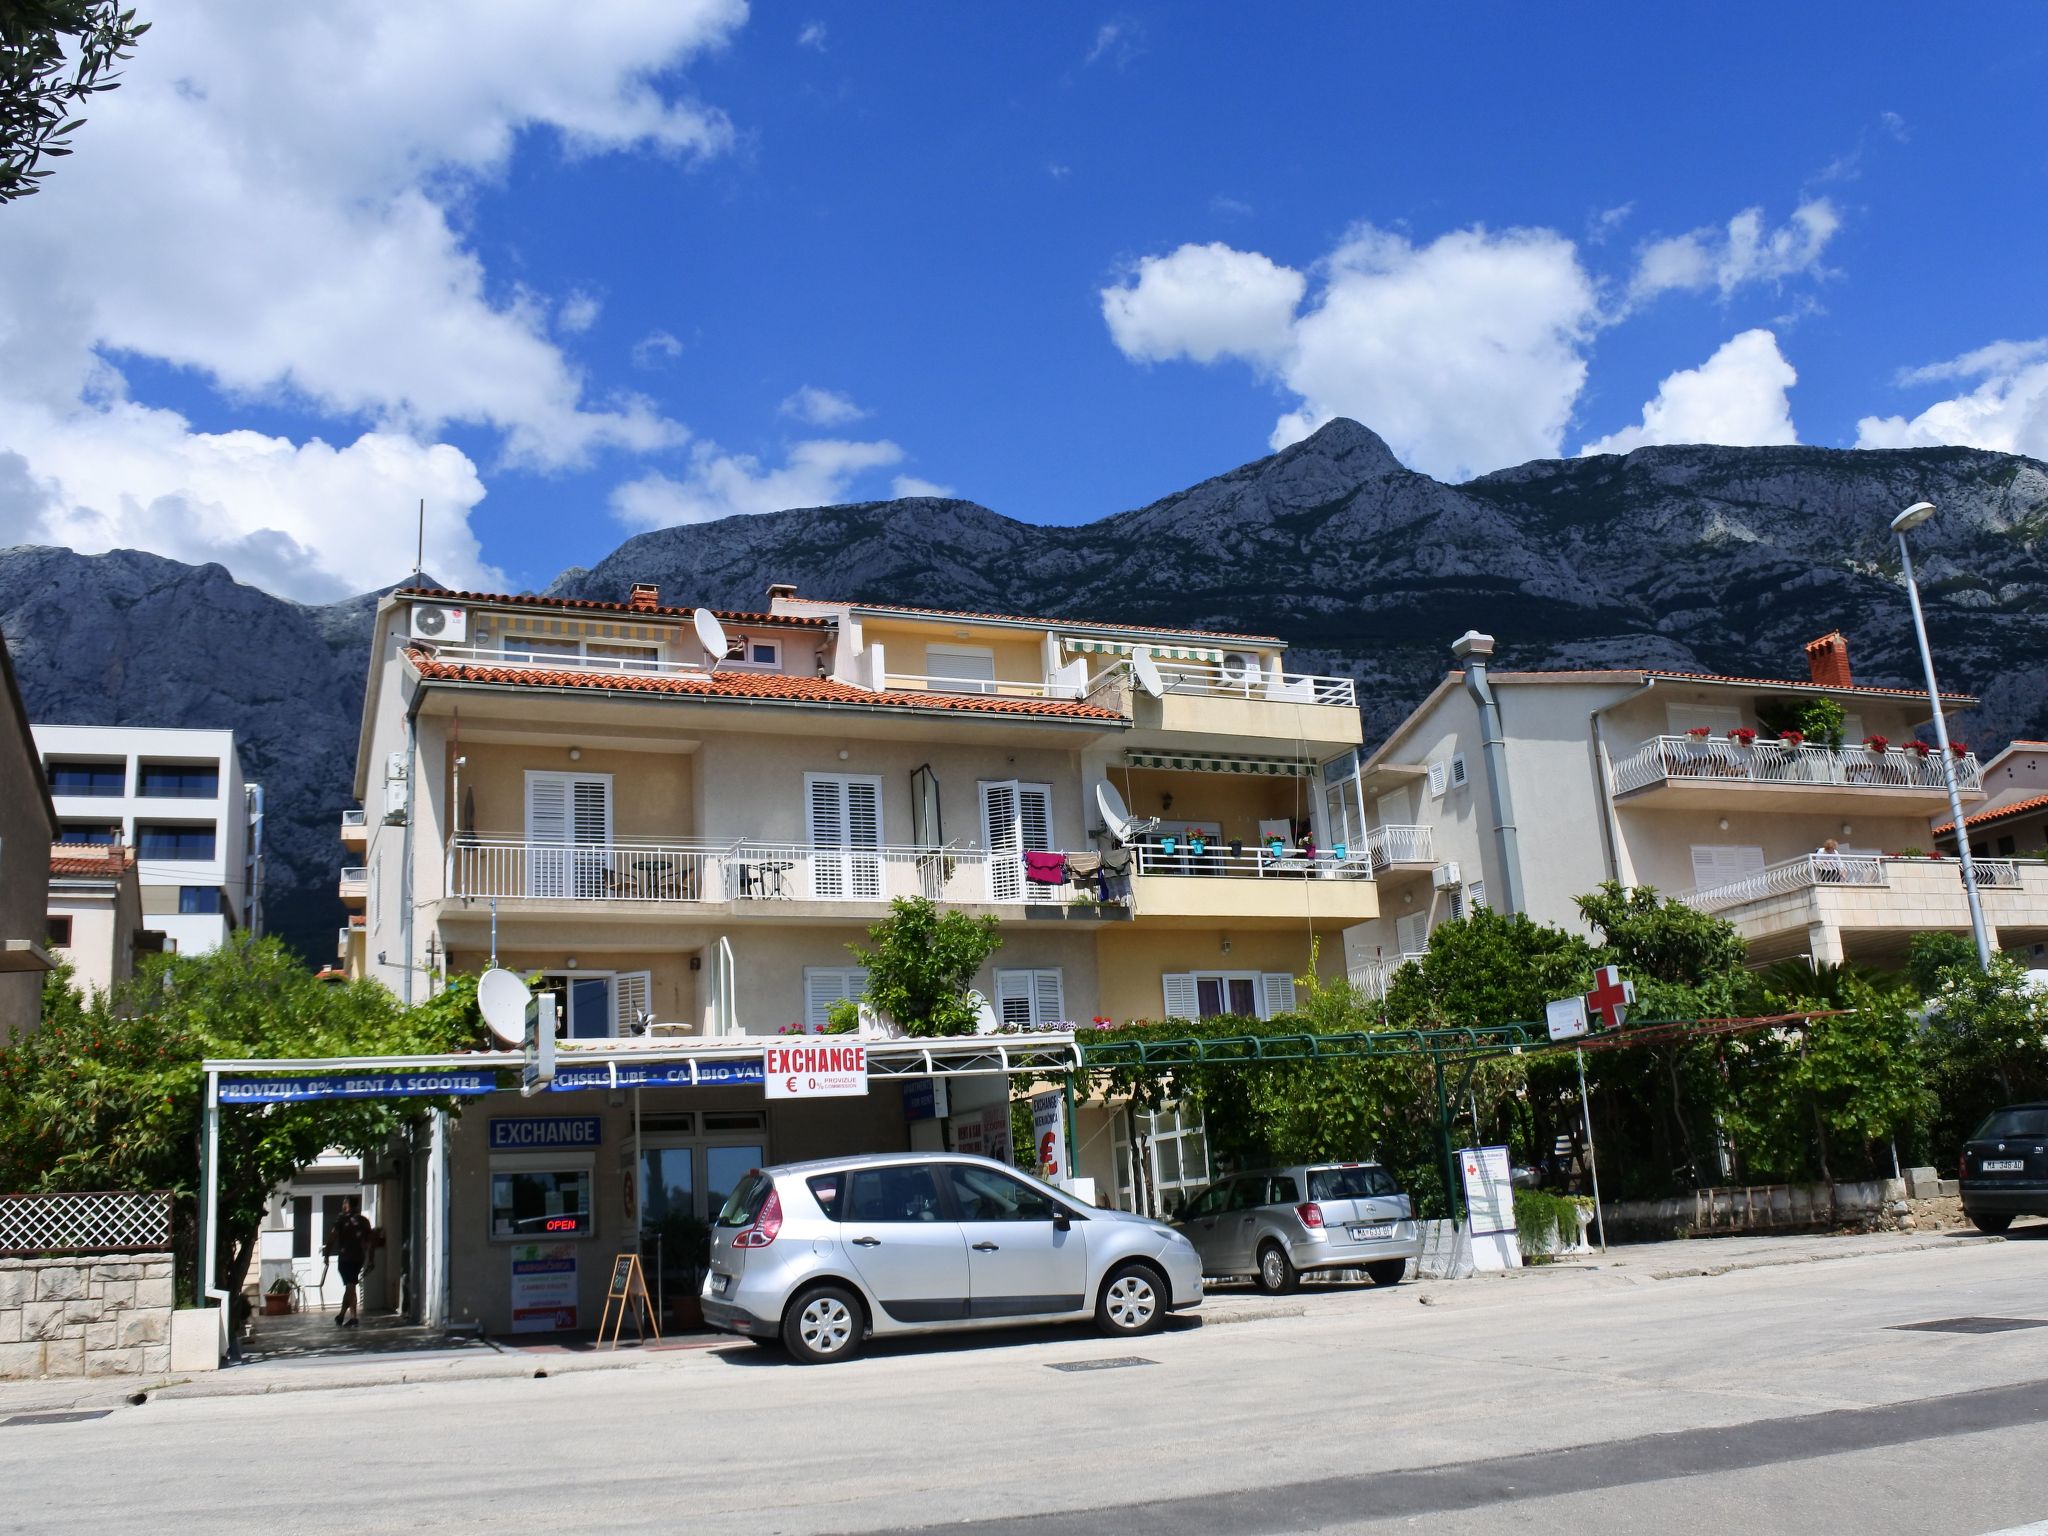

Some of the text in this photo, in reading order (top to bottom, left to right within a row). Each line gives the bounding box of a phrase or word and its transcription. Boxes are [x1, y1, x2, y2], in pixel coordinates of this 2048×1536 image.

[767, 1047, 865, 1074] EXCHANGE
[551, 1071, 647, 1087] ECHSELSUBE
[734, 1066, 765, 1079] VAL
[785, 1076, 798, 1093] €
[219, 1077, 481, 1098] PROVIZIJA 0% RENT A SCOOTER
[1034, 1095, 1057, 1113] EXCHANGE
[495, 1121, 596, 1144] EXCHANGE
[546, 1219, 576, 1231] OPEN
